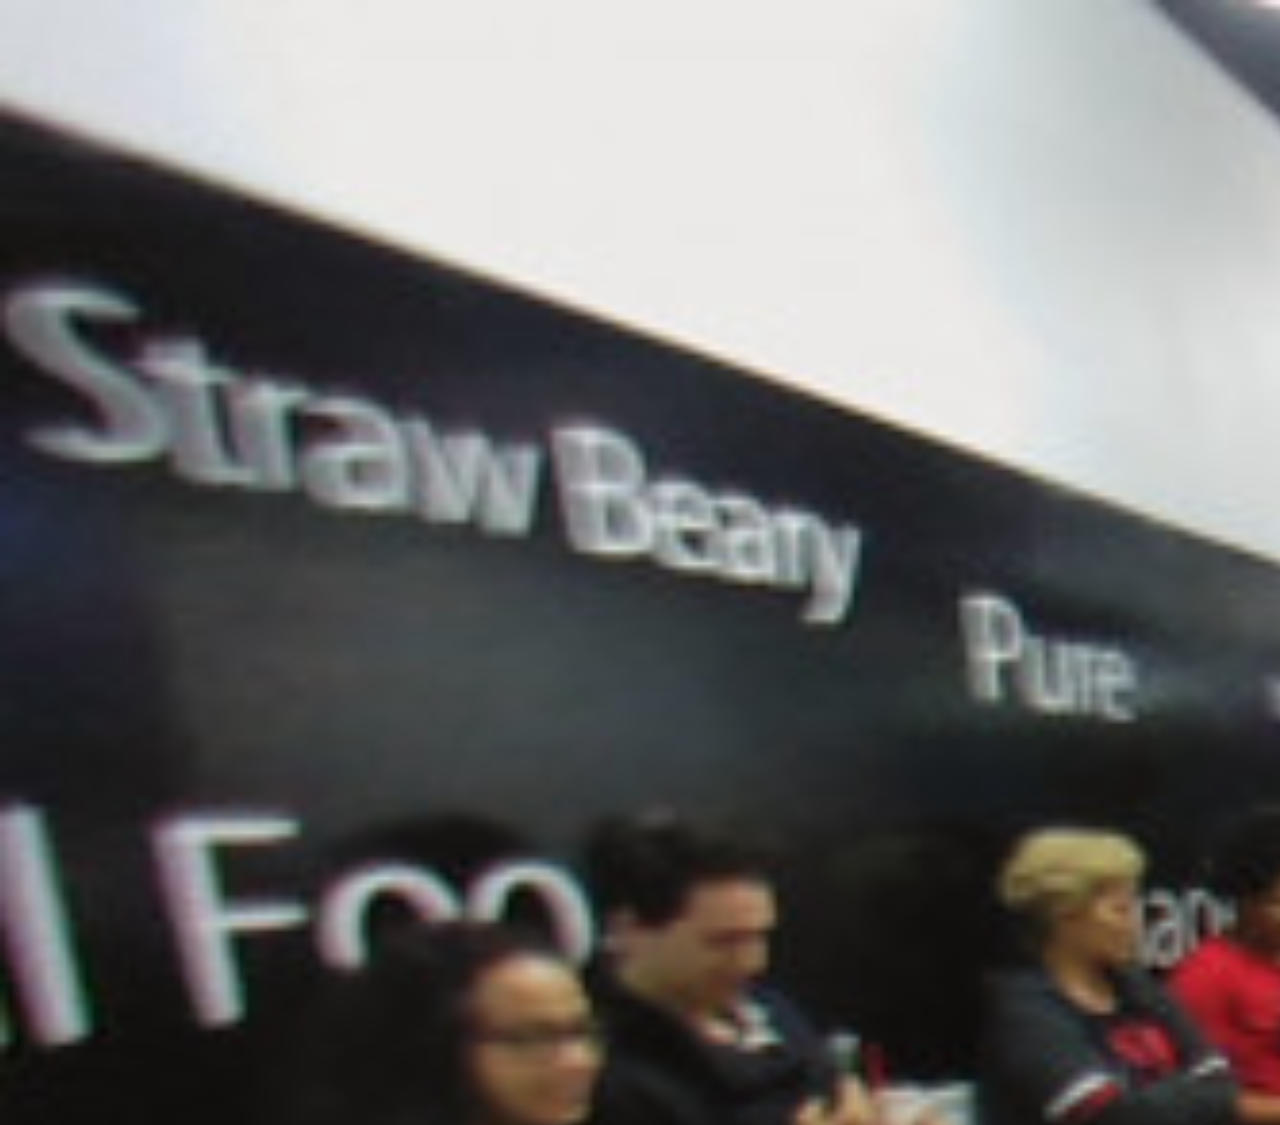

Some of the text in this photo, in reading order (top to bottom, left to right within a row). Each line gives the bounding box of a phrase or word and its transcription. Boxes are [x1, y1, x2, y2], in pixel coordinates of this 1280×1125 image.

[2, 280, 862, 624] Straw Beary
[958, 594, 1138, 724] Pure
[152, 808, 598, 1030] Foo
